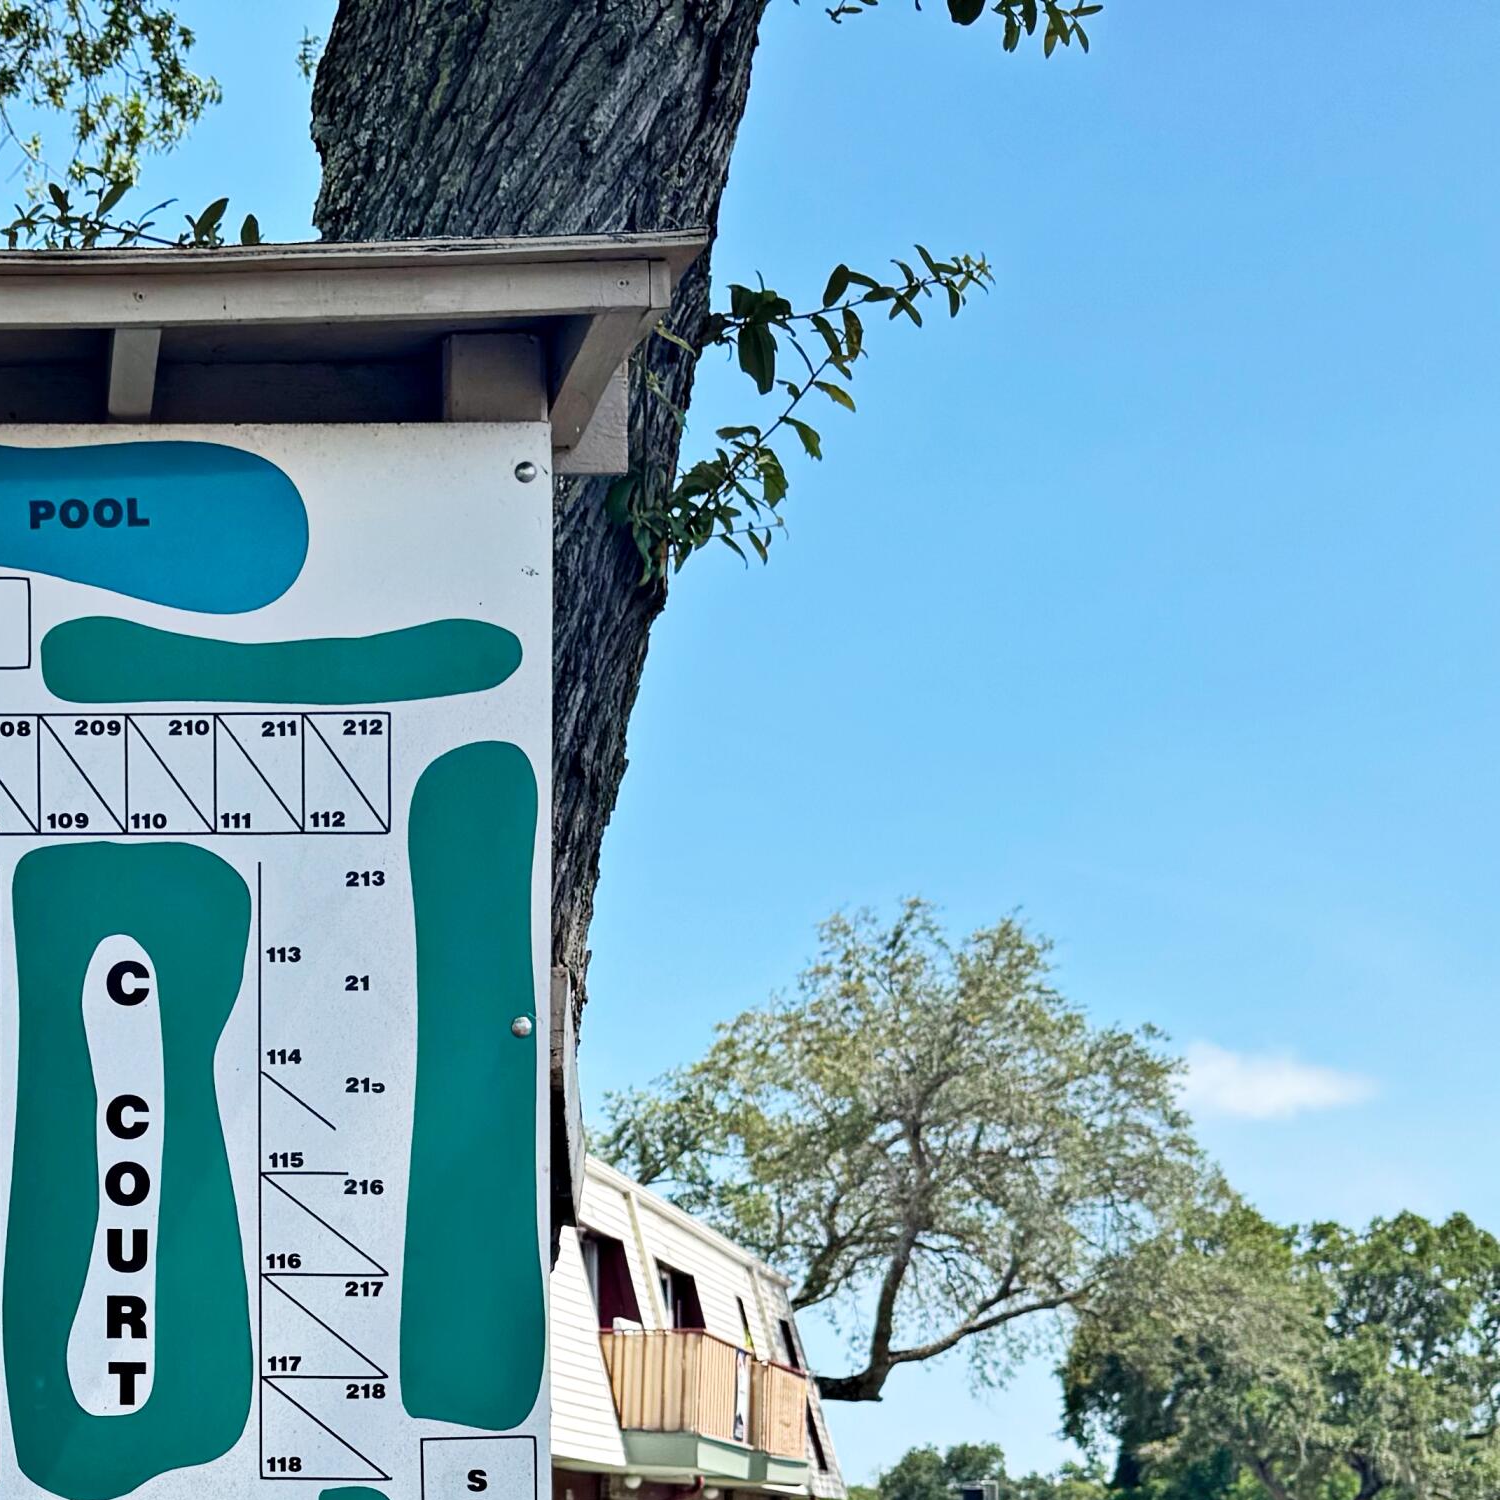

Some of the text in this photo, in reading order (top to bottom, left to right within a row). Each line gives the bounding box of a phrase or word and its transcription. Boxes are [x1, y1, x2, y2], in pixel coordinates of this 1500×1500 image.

[30, 498, 149, 529] POOL
[74, 719, 122, 737] 209
[168, 719, 210, 736] 210
[261, 720, 297, 738] 211
[342, 719, 383, 736] 212
[46, 812, 89, 829] 109
[130, 812, 168, 830] 110
[220, 812, 251, 829] 111
[309, 810, 346, 828] 112
[345, 870, 386, 887] 213
[265, 946, 302, 963] 113
[344, 975, 370, 992] 21
[266, 1048, 302, 1065] 114
[268, 1151, 304, 1168] 115
[104, 960, 151, 1406] C COURT
[343, 1178, 384, 1196] 216
[265, 1253, 302, 1269] 116
[344, 1281, 384, 1297] 217
[267, 1355, 302, 1372] 117
[346, 1383, 386, 1400] 218
[266, 1456, 302, 1473] 118
